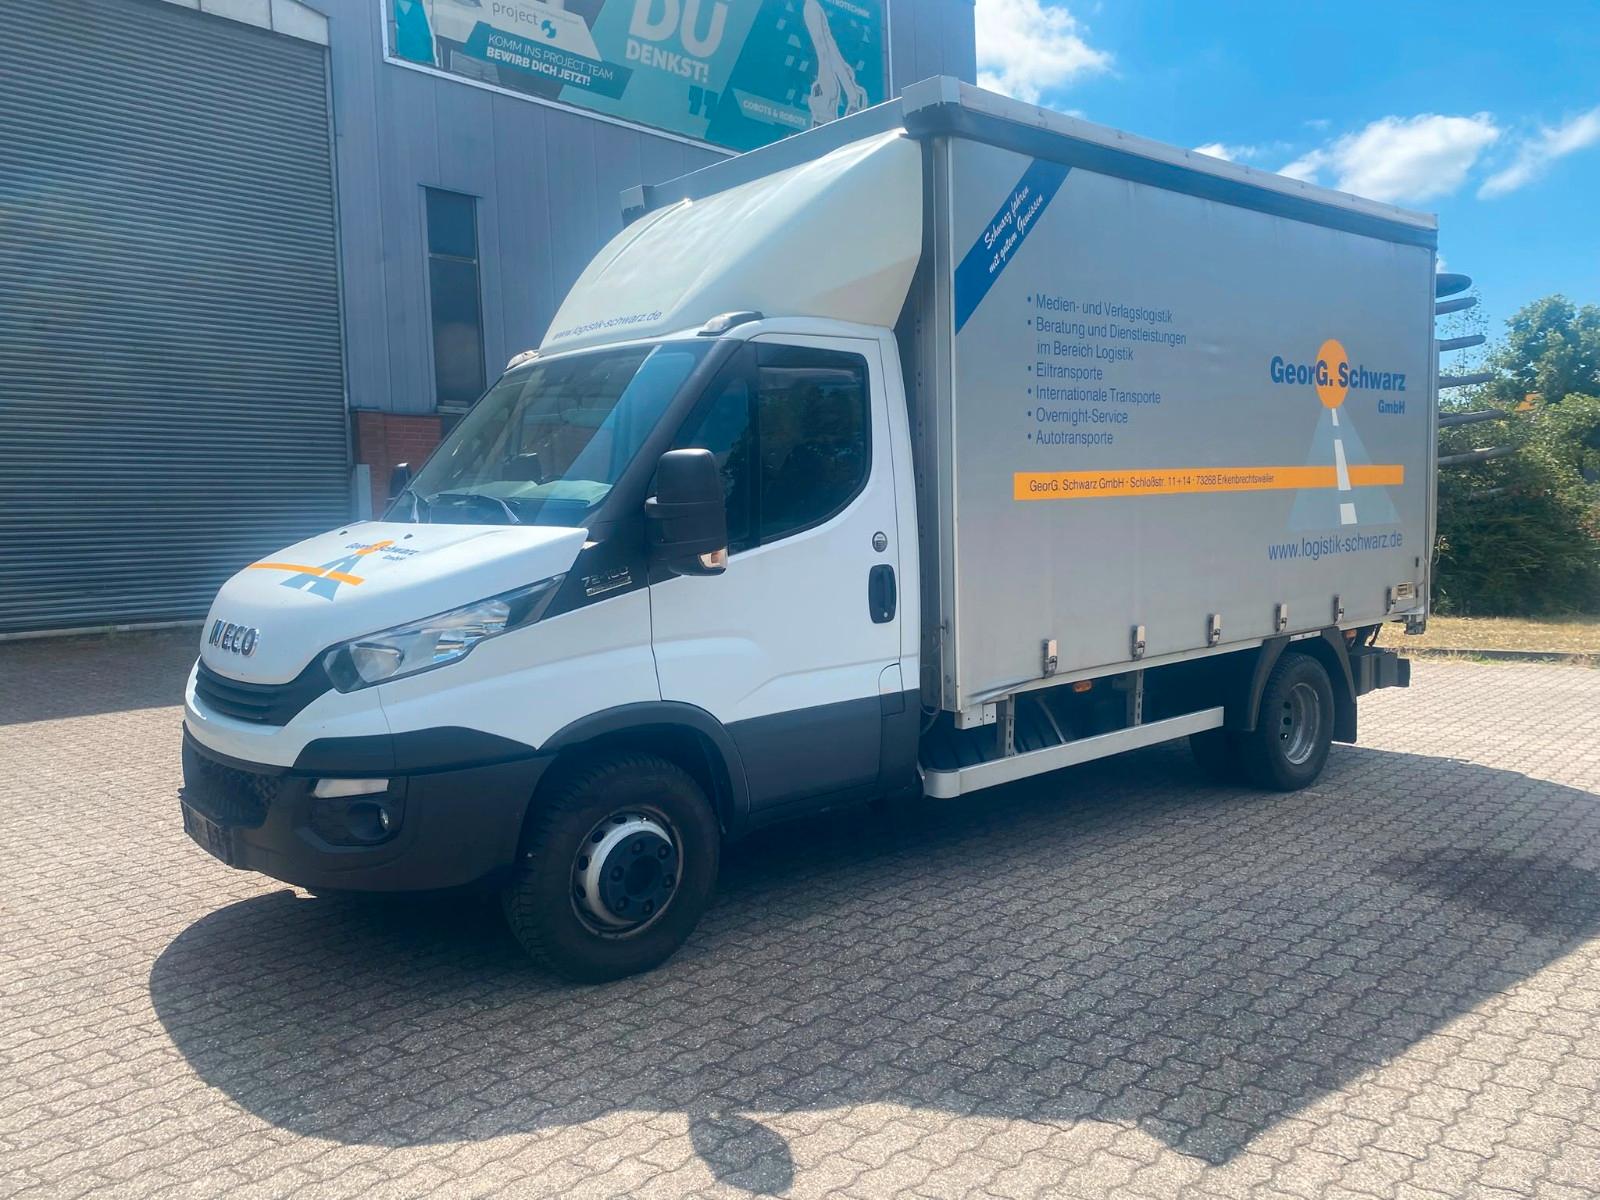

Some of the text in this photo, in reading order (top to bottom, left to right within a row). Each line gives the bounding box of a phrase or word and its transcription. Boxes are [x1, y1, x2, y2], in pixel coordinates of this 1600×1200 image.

[492, 2, 539, 25] project
[486, 46, 592, 86] BEWIRB DICH JETZT!
[487, 33, 614, 81] KOMM INS PROJECT TEAM
[625, 37, 709, 84] DENKST!
[984, 211, 1012, 250] Schwarz
[1036, 293, 1174, 325] Medien- und Verlagslogistik
[1036, 316, 1187, 347] Beratung und Dienstleistungen
[1037, 340, 1134, 363] im Bereich Logistik
[1036, 362, 1103, 381] Eiltransporte
[1270, 355, 1406, 391] GeorG. Schwarz
[1036, 385, 1161, 406] Internationale Transporte
[1378, 399, 1406, 414] GmbH
[1036, 407, 1128, 426] Overnight-Service
[1036, 429, 1113, 447] Autotransporte
[1062, 478, 1098, 491] Schwarz
[1099, 477, 1125, 489] GmbH
[1268, 530, 1403, 560] www.logistik-schwarz.de
[208, 618, 260, 656] IVECO
